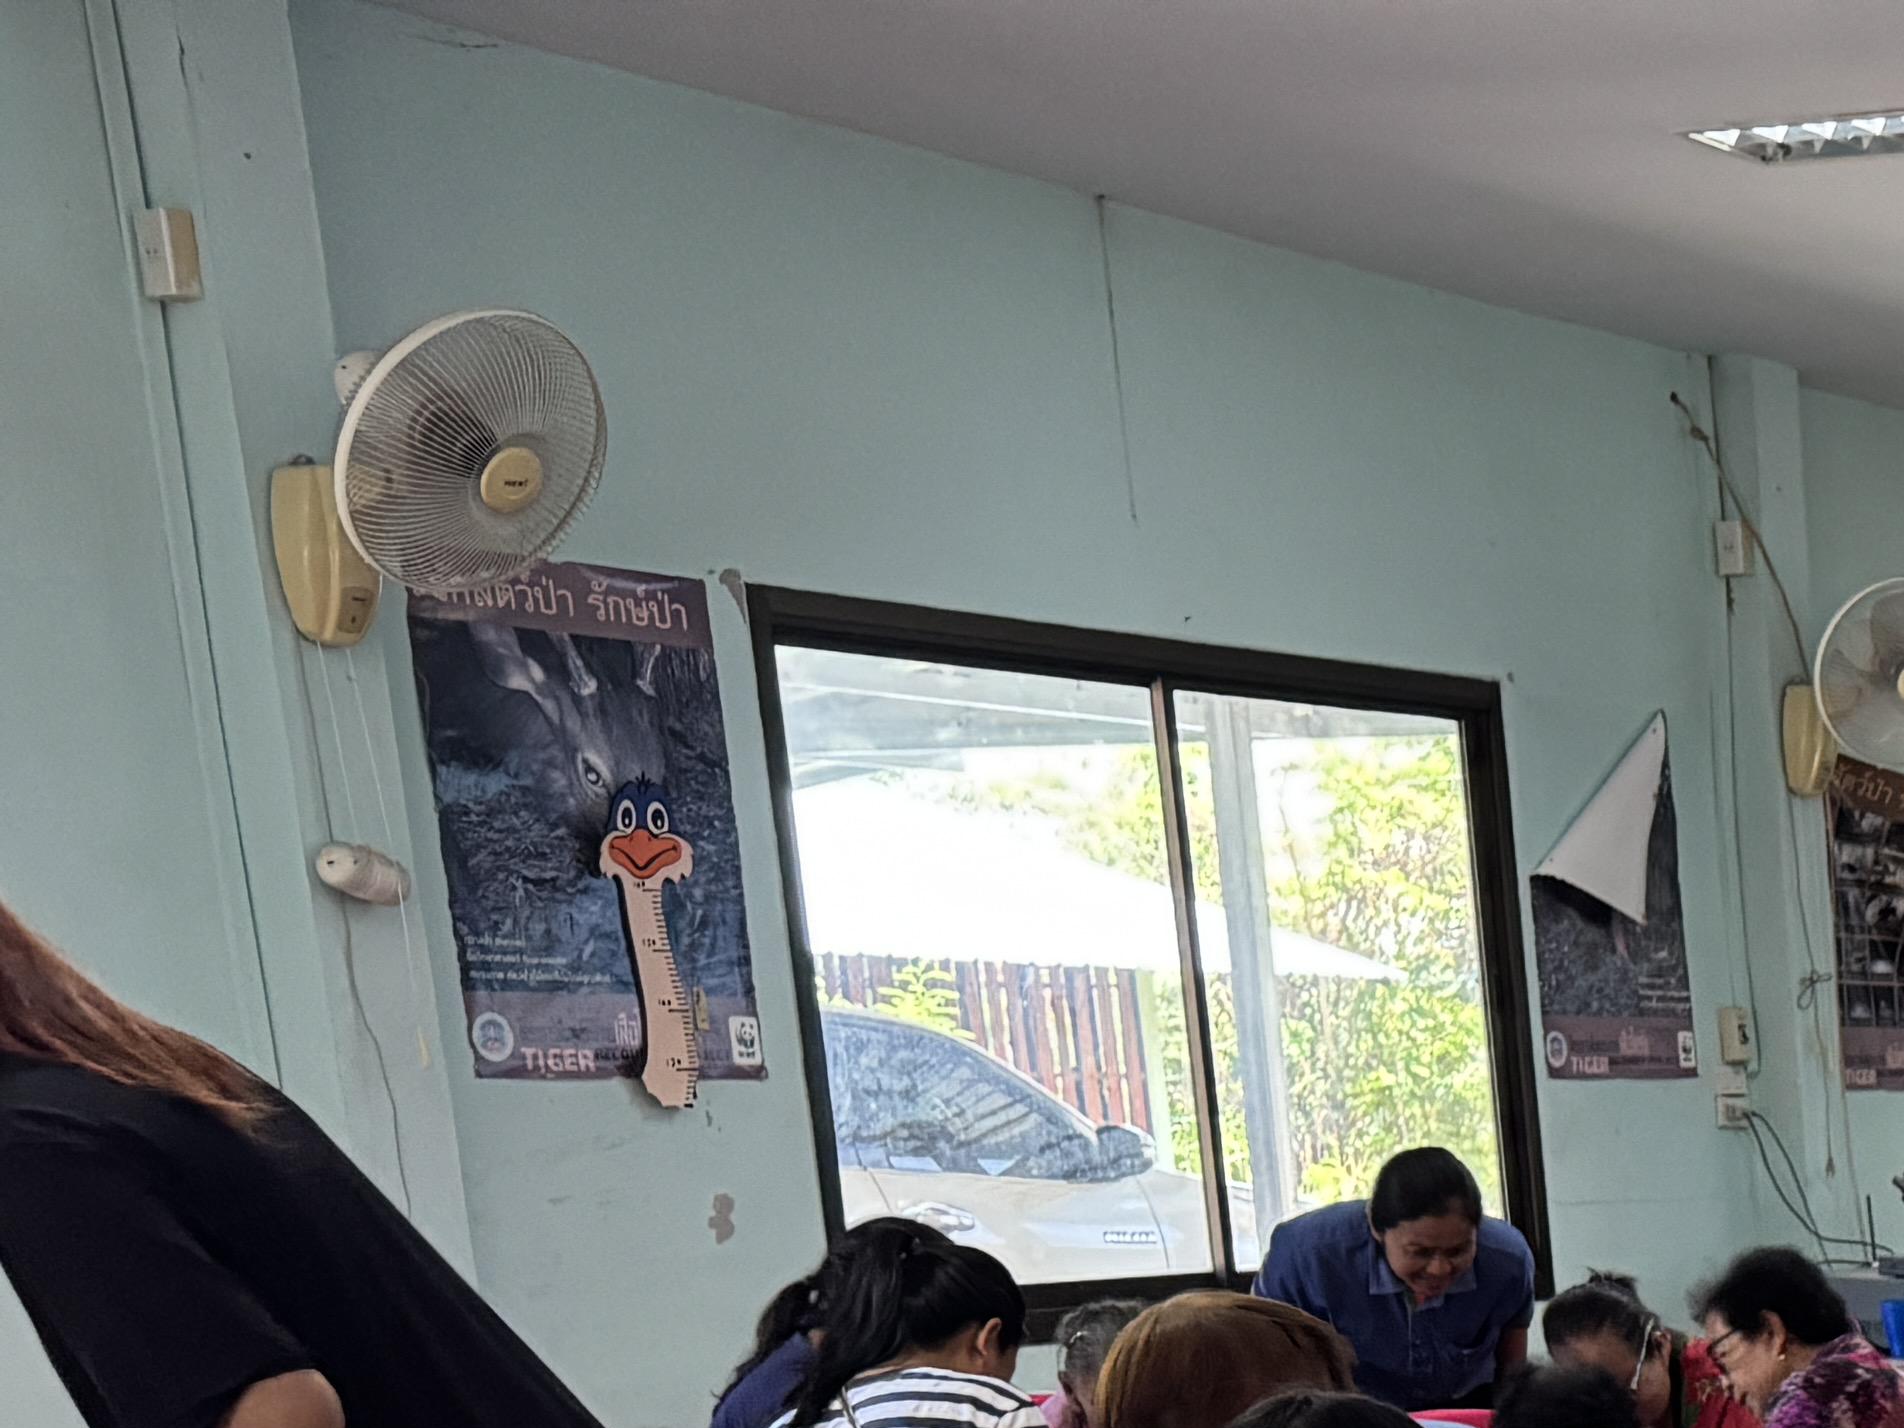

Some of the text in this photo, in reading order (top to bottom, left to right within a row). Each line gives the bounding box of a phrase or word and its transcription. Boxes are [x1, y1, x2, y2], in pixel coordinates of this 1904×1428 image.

[587, 579, 688, 632] รักษ์ป่า
[520, 1046, 597, 1074] TIGER
